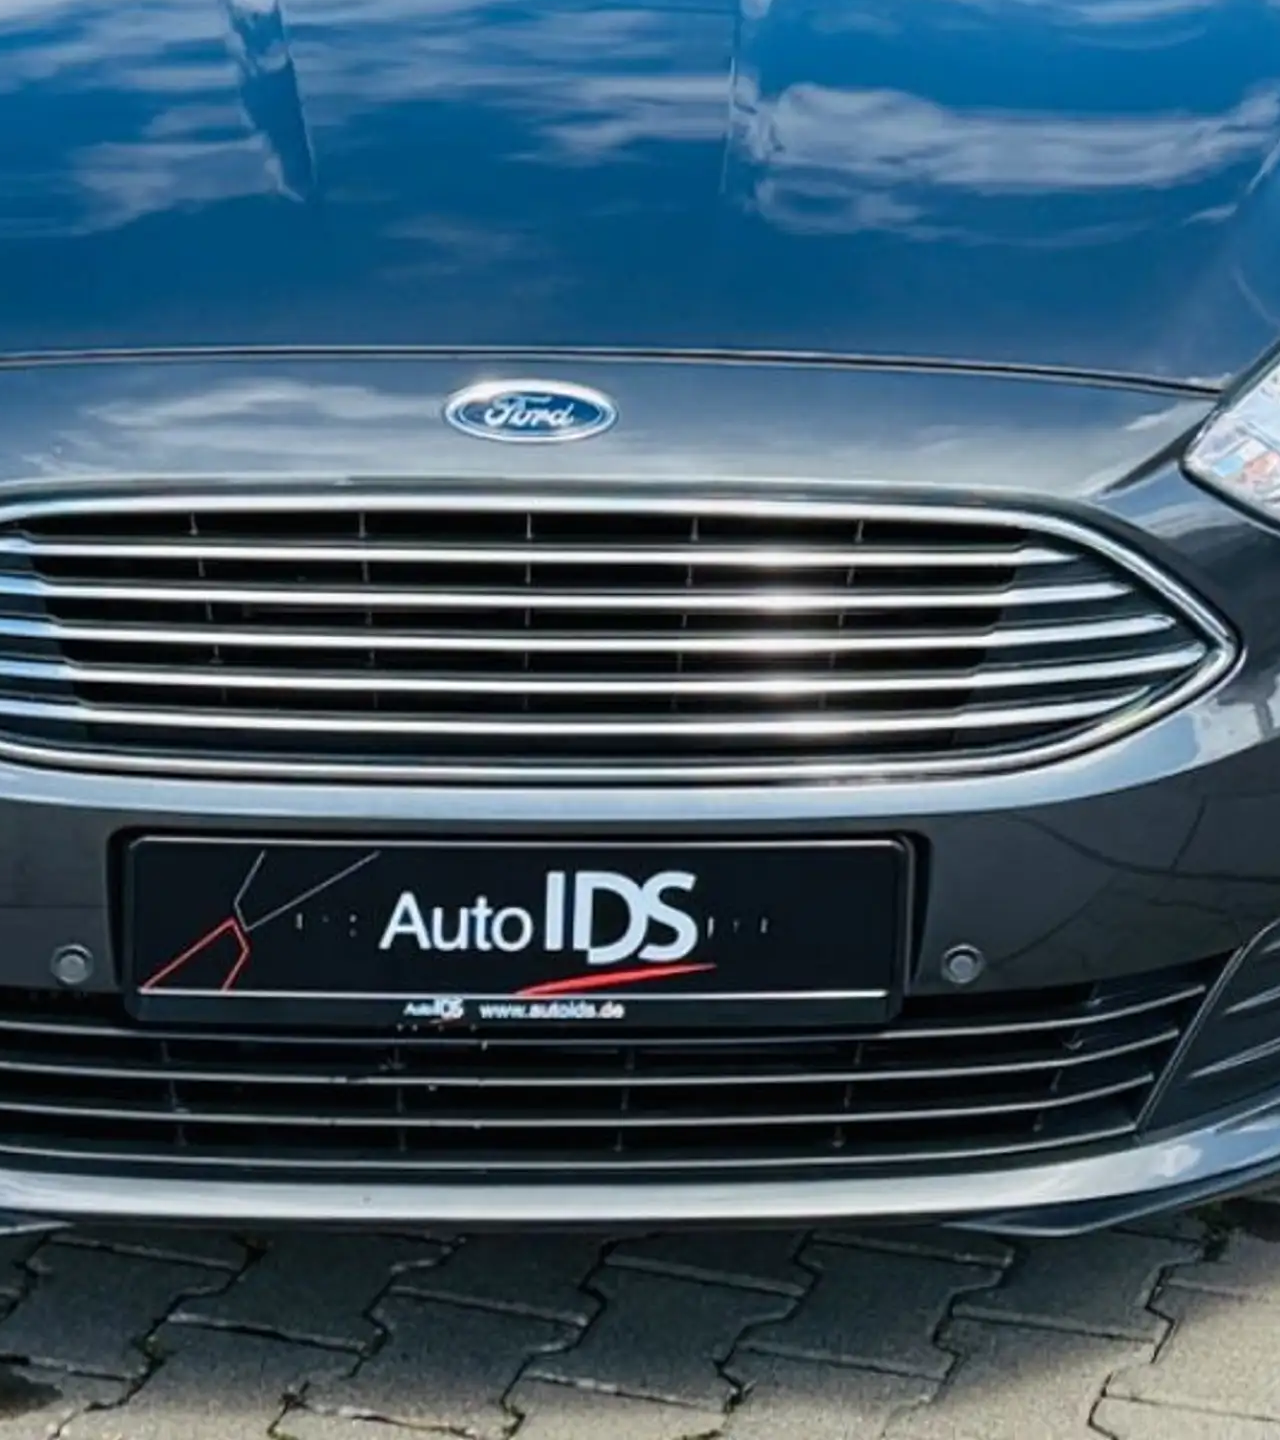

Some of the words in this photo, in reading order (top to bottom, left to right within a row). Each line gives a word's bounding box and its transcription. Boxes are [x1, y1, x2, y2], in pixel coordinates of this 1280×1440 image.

[484, 394, 575, 427] Ford
[378, 891, 534, 952] Auto
[544, 870, 699, 965] IDS
[478, 1000, 625, 1019] www.autoids.de
